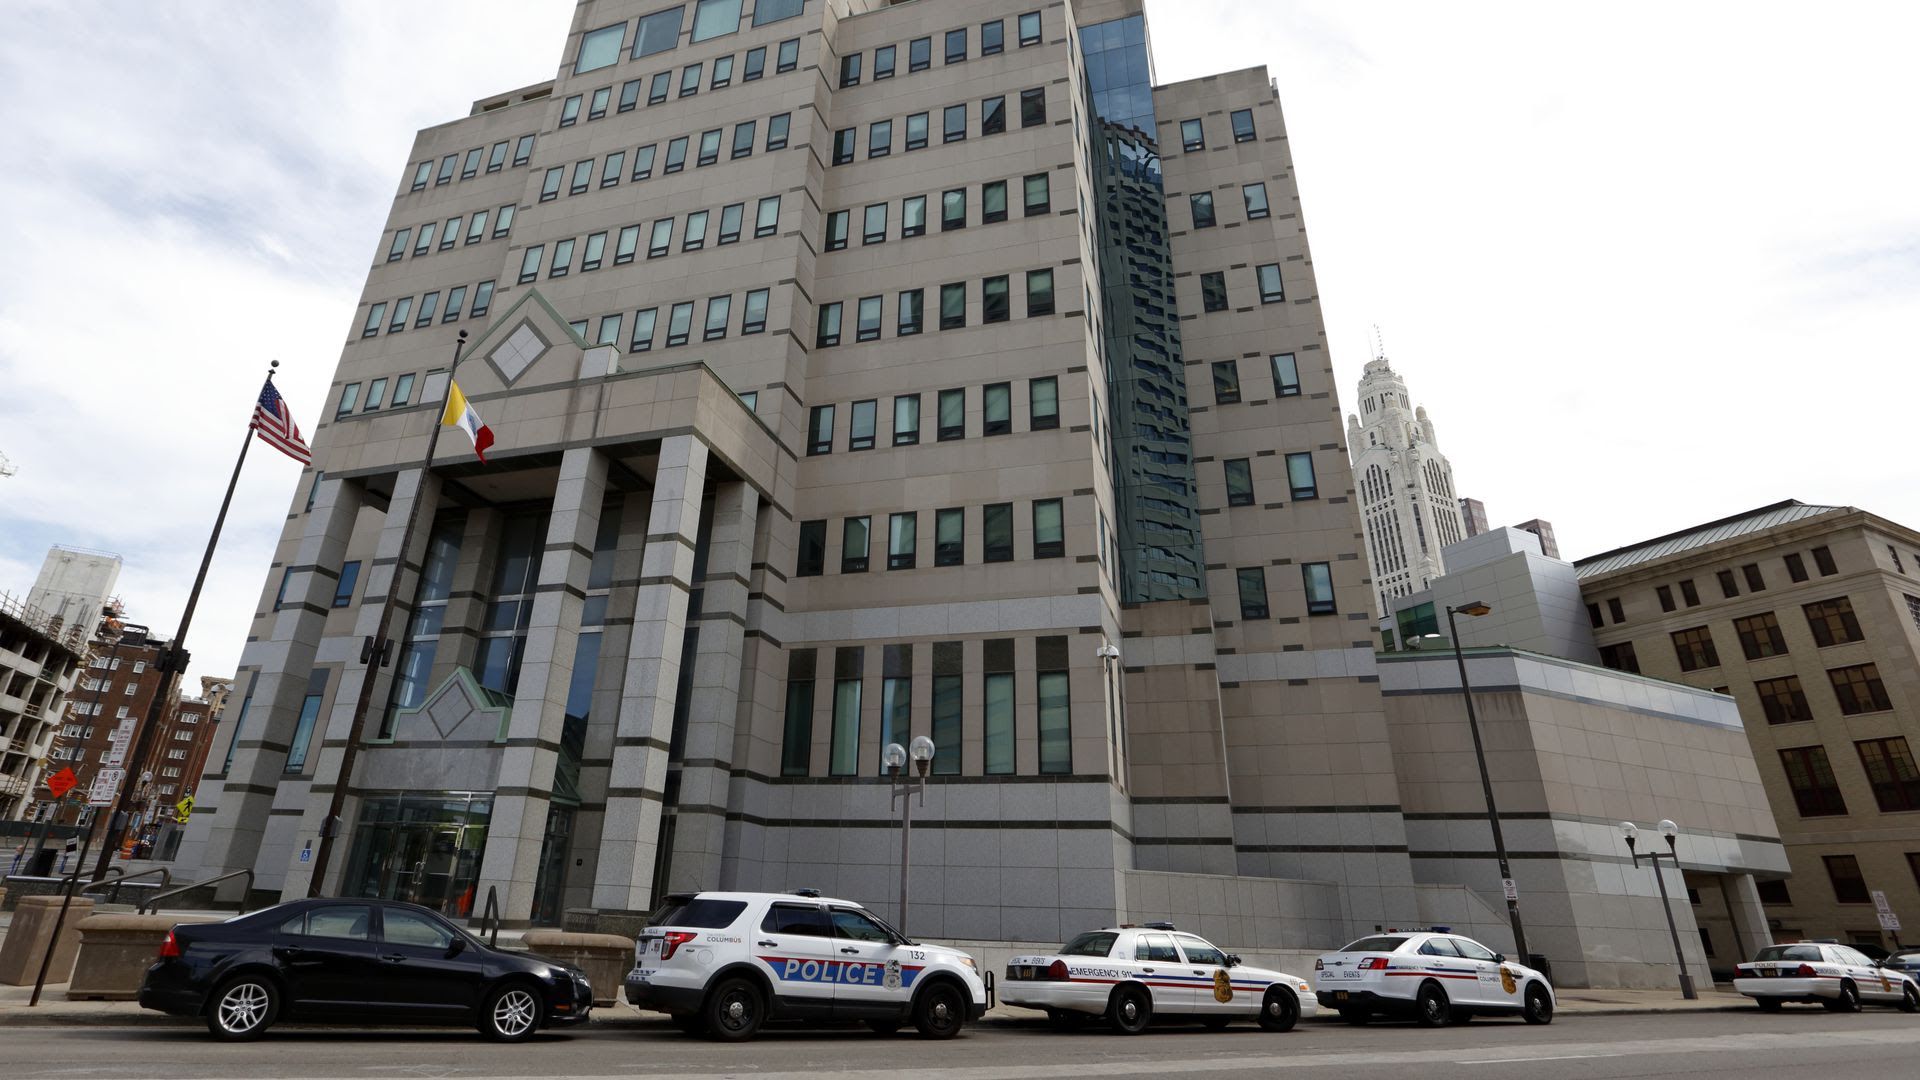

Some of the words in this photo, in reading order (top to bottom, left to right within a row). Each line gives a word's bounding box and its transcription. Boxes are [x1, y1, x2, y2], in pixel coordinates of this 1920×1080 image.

[910, 951, 925, 960] 132
[783, 959, 878, 984] POLICE
[1070, 967, 1119, 978] EMERGENCY
[1343, 970, 1360, 978] EVENTS
